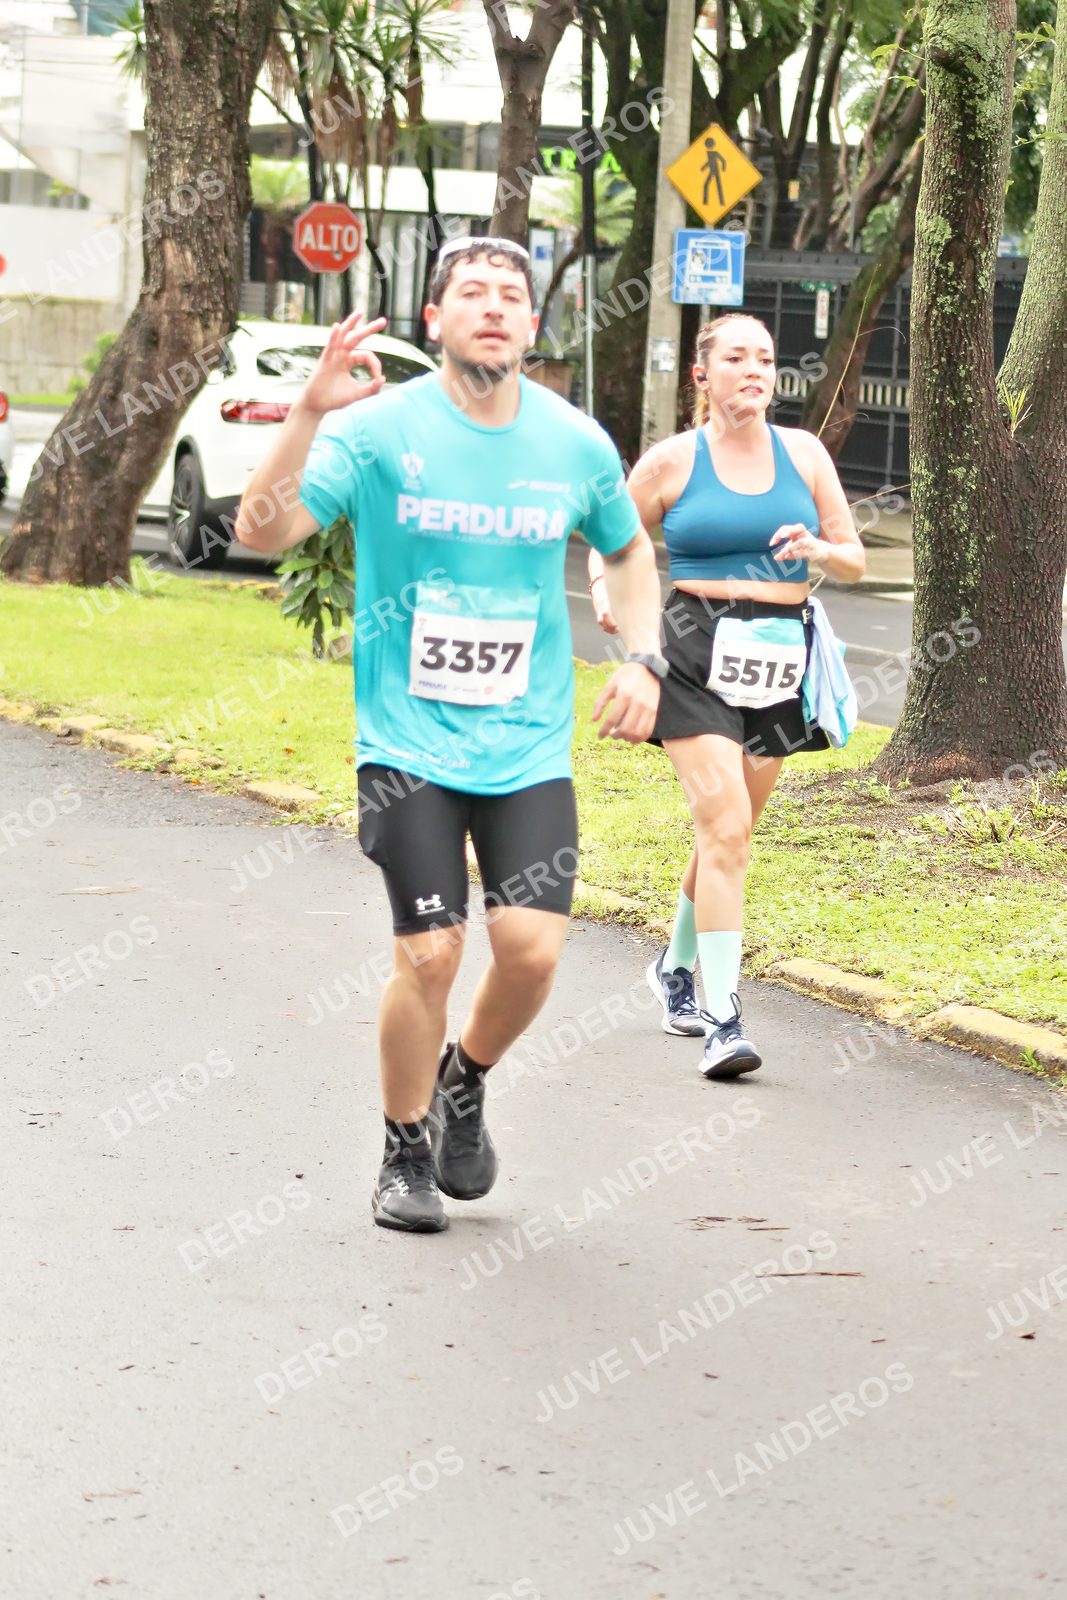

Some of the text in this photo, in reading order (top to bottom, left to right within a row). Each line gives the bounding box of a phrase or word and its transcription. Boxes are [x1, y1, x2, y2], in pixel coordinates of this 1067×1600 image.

[300, 223, 359, 252] ALTO
[397, 493, 568, 541] PERDURA
[420, 636, 524, 674] 3357
[718, 655, 798, 688] 5515
